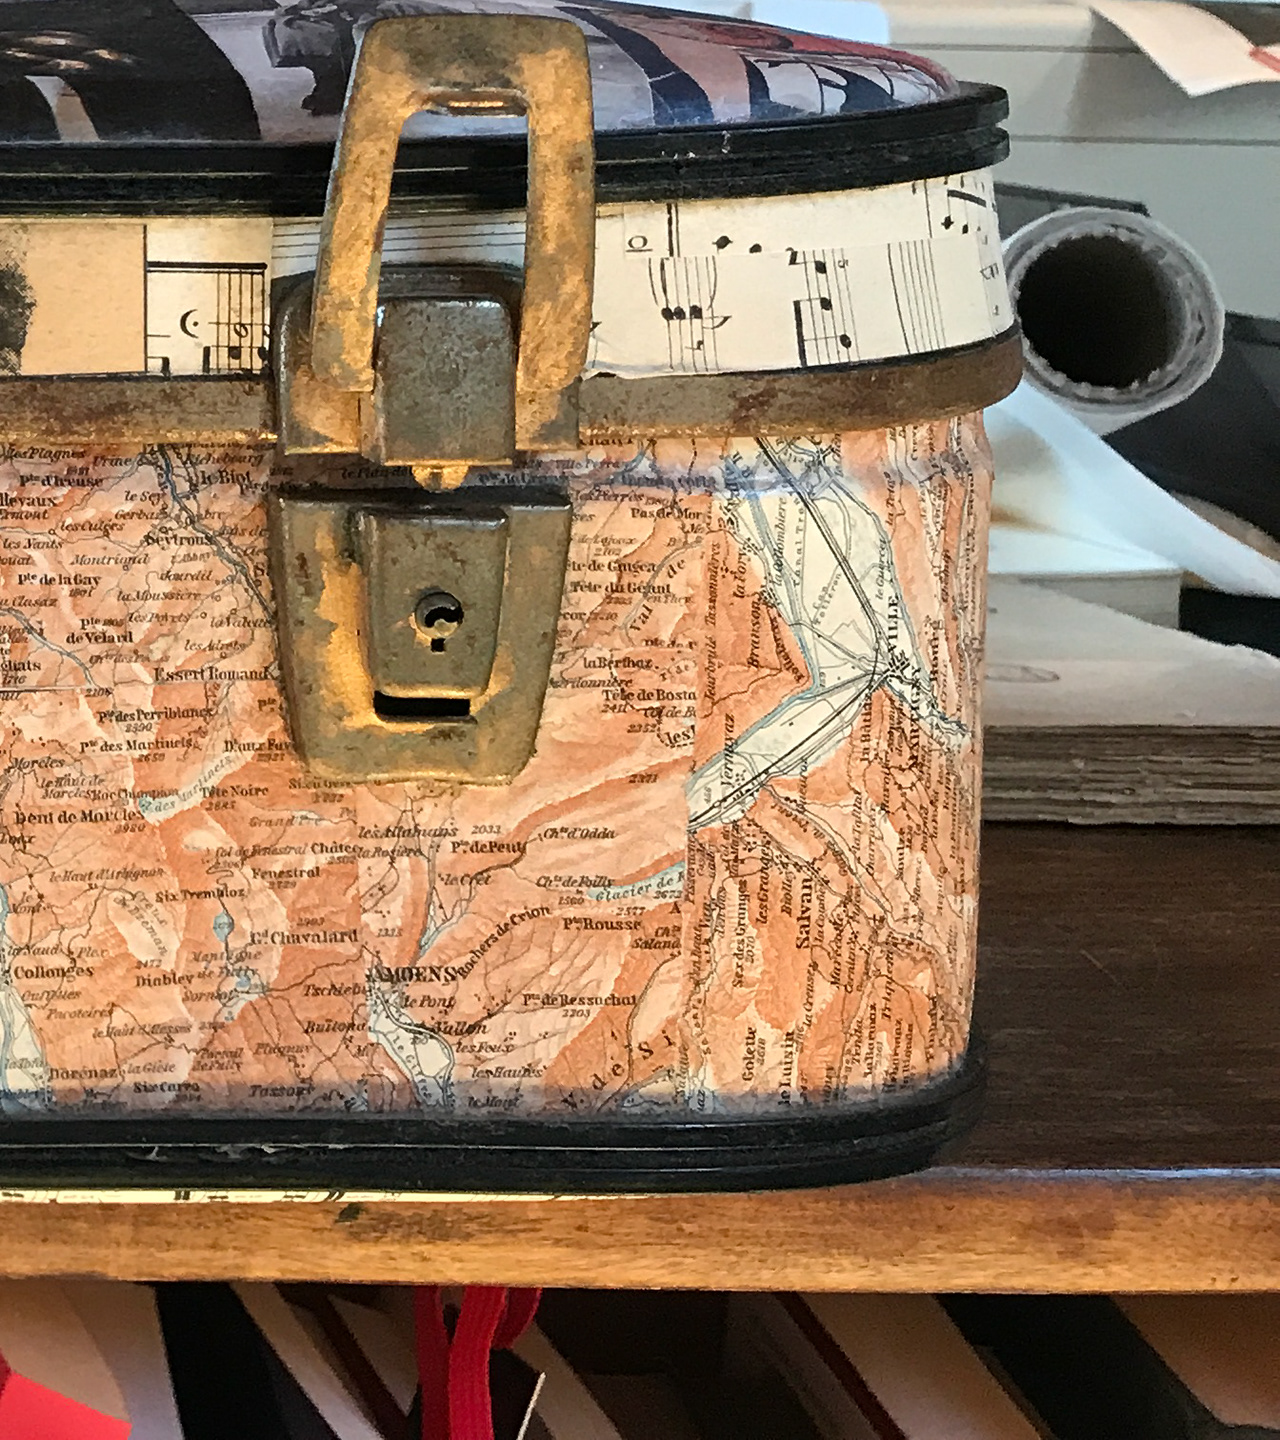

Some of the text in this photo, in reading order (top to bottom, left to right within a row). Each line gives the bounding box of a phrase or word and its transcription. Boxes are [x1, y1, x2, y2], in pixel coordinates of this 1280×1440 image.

[220, 471, 251, 484] Biot
[74, 575, 101, 588] Gay
[888, 596, 898, 652] VILLE
[748, 600, 760, 668] Branson
[154, 667, 272, 681] Essert Romand
[12, 756, 64, 768] Morcles
[201, 785, 269, 798] Tête Noire
[15, 809, 143, 824] Dent de Morcles
[253, 867, 320, 879] Fenestral
[736, 879, 749, 936] Granges
[756, 903, 767, 924] les
[797, 878, 812, 948] Salvan
[509, 905, 550, 927] Crion
[584, 917, 641, 931] Rousse
[272, 930, 359, 944] Chavalard
[735, 938, 745, 959] des
[14, 964, 94, 980] Collonges
